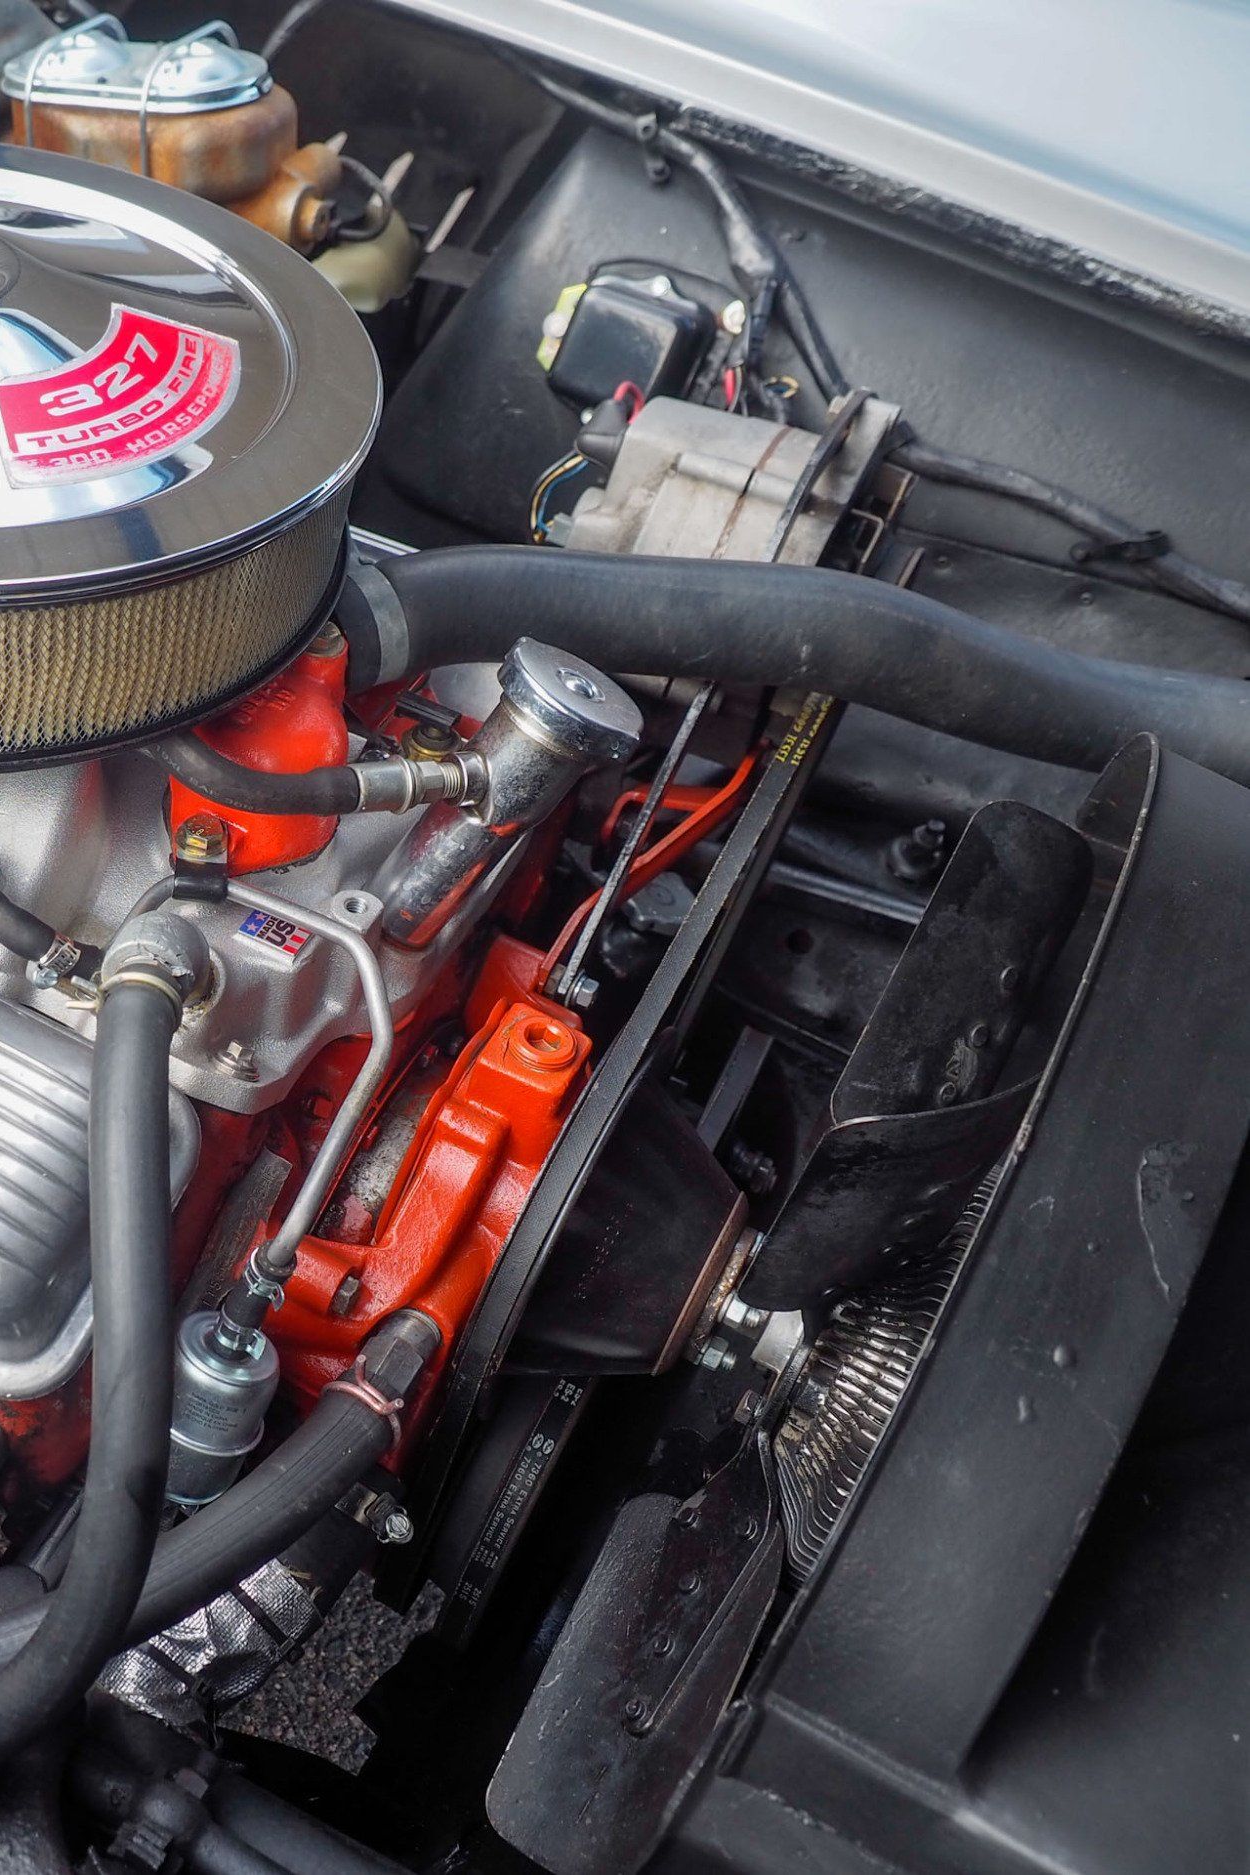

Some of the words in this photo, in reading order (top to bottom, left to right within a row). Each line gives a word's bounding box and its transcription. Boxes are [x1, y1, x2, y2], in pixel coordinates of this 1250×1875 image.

[27, 338, 197, 448] TURBO-FIRE
[39, 332, 158, 417] 327
[126, 345, 228, 453] HORSEPO
[256, 916, 279, 939] MADE
[515, 1456, 532, 1481] 7360
[525, 1462, 542, 1487] 7360
